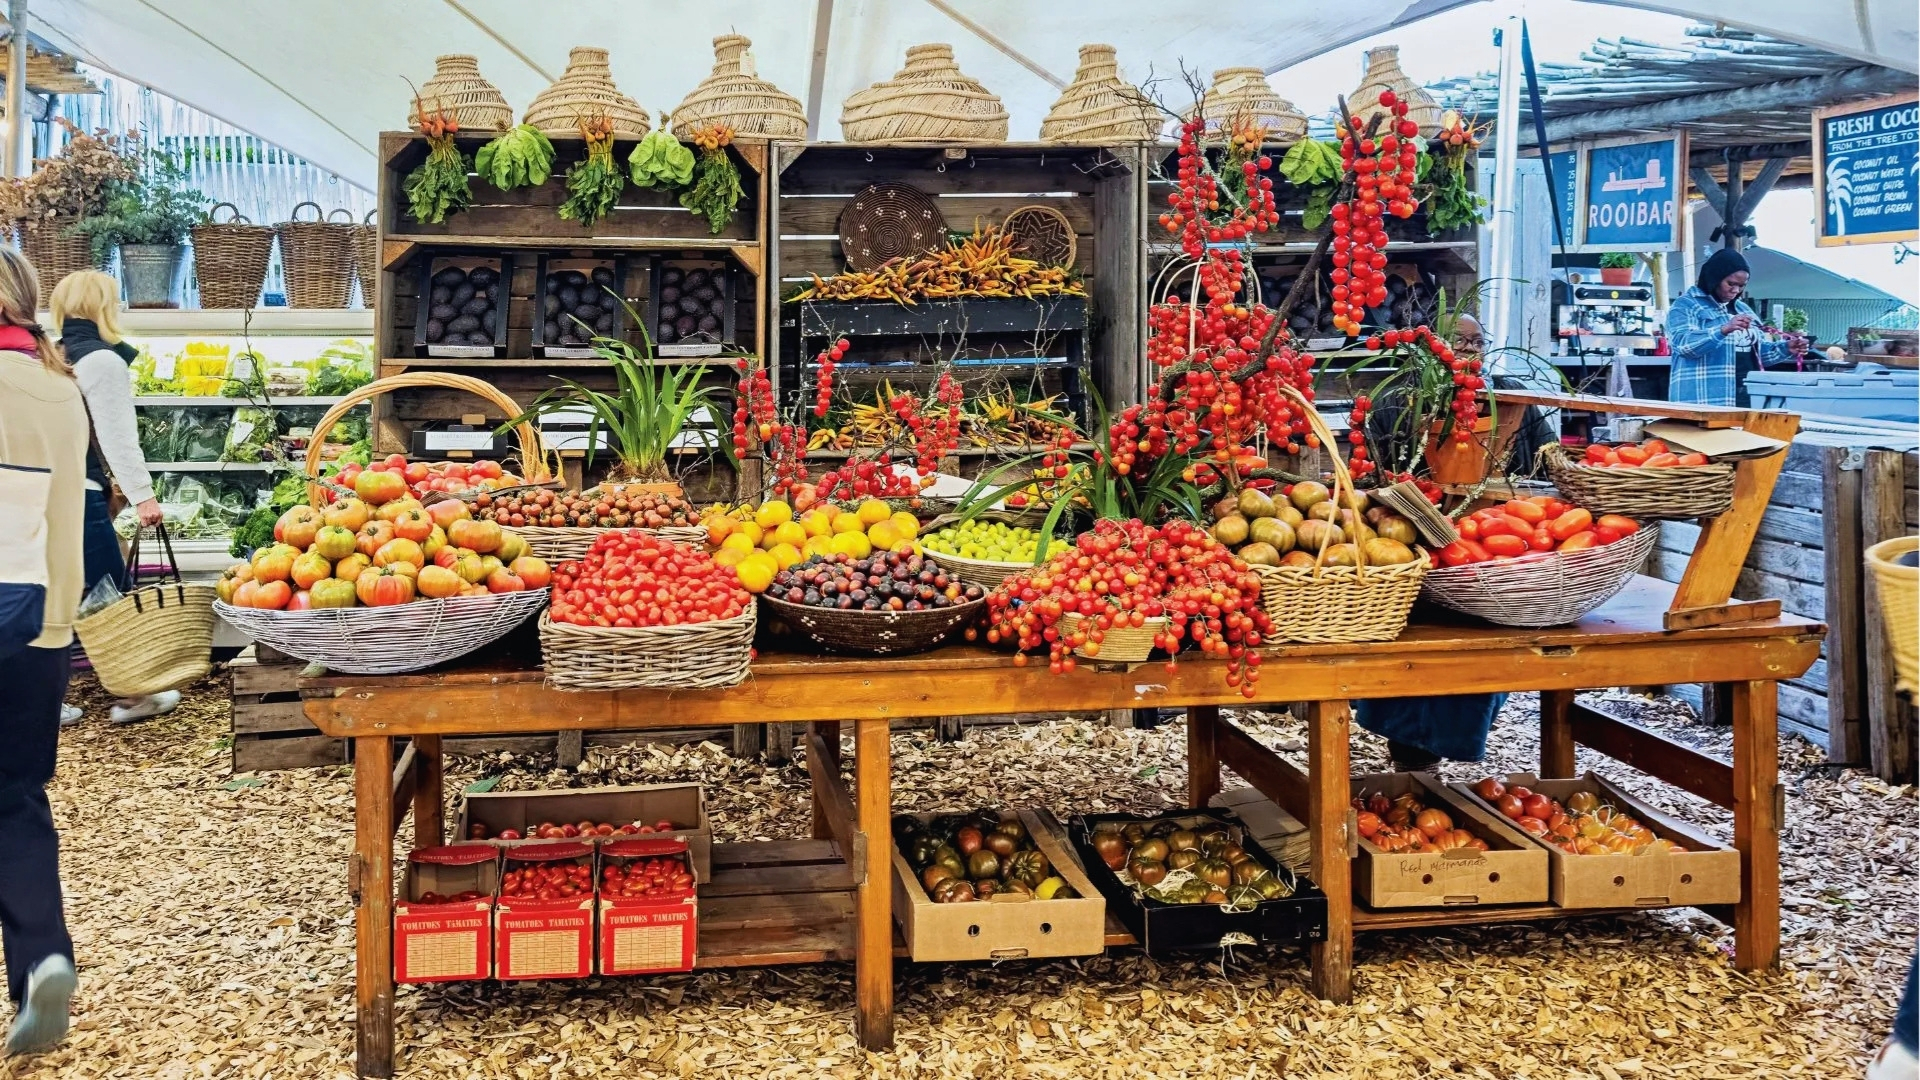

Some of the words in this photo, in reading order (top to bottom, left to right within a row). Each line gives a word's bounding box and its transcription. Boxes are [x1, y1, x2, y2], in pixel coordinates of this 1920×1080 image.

[1828, 116, 1875, 139] FRESH
[1832, 143, 1853, 152] FROM
[1856, 139, 1872, 148] THE
[1876, 135, 1898, 144] TREE
[1854, 158, 1884, 170] COCONUT
[1887, 156, 1899, 166] OIL
[1852, 172, 1880, 182] COCONUT
[1881, 168, 1905, 179] WATER
[1854, 183, 1881, 194] COCONUT
[1854, 194, 1882, 206] COCONUT
[1884, 191, 1909, 202] BROWN
[1589, 200, 1672, 228] ROOIBAR
[1853, 205, 1884, 218] COCONUT
[1885, 203, 1913, 215] GREEN
[1400, 857, 1422, 877] Red
[402, 920, 441, 931] TOMATOES
[446, 918, 483, 929] TAMATIES
[505, 919, 544, 929] TOMATOES
[549, 917, 585, 927] TAMATIES
[610, 914, 648, 925] TOMATOES
[652, 912, 688, 922] TAMATIES
